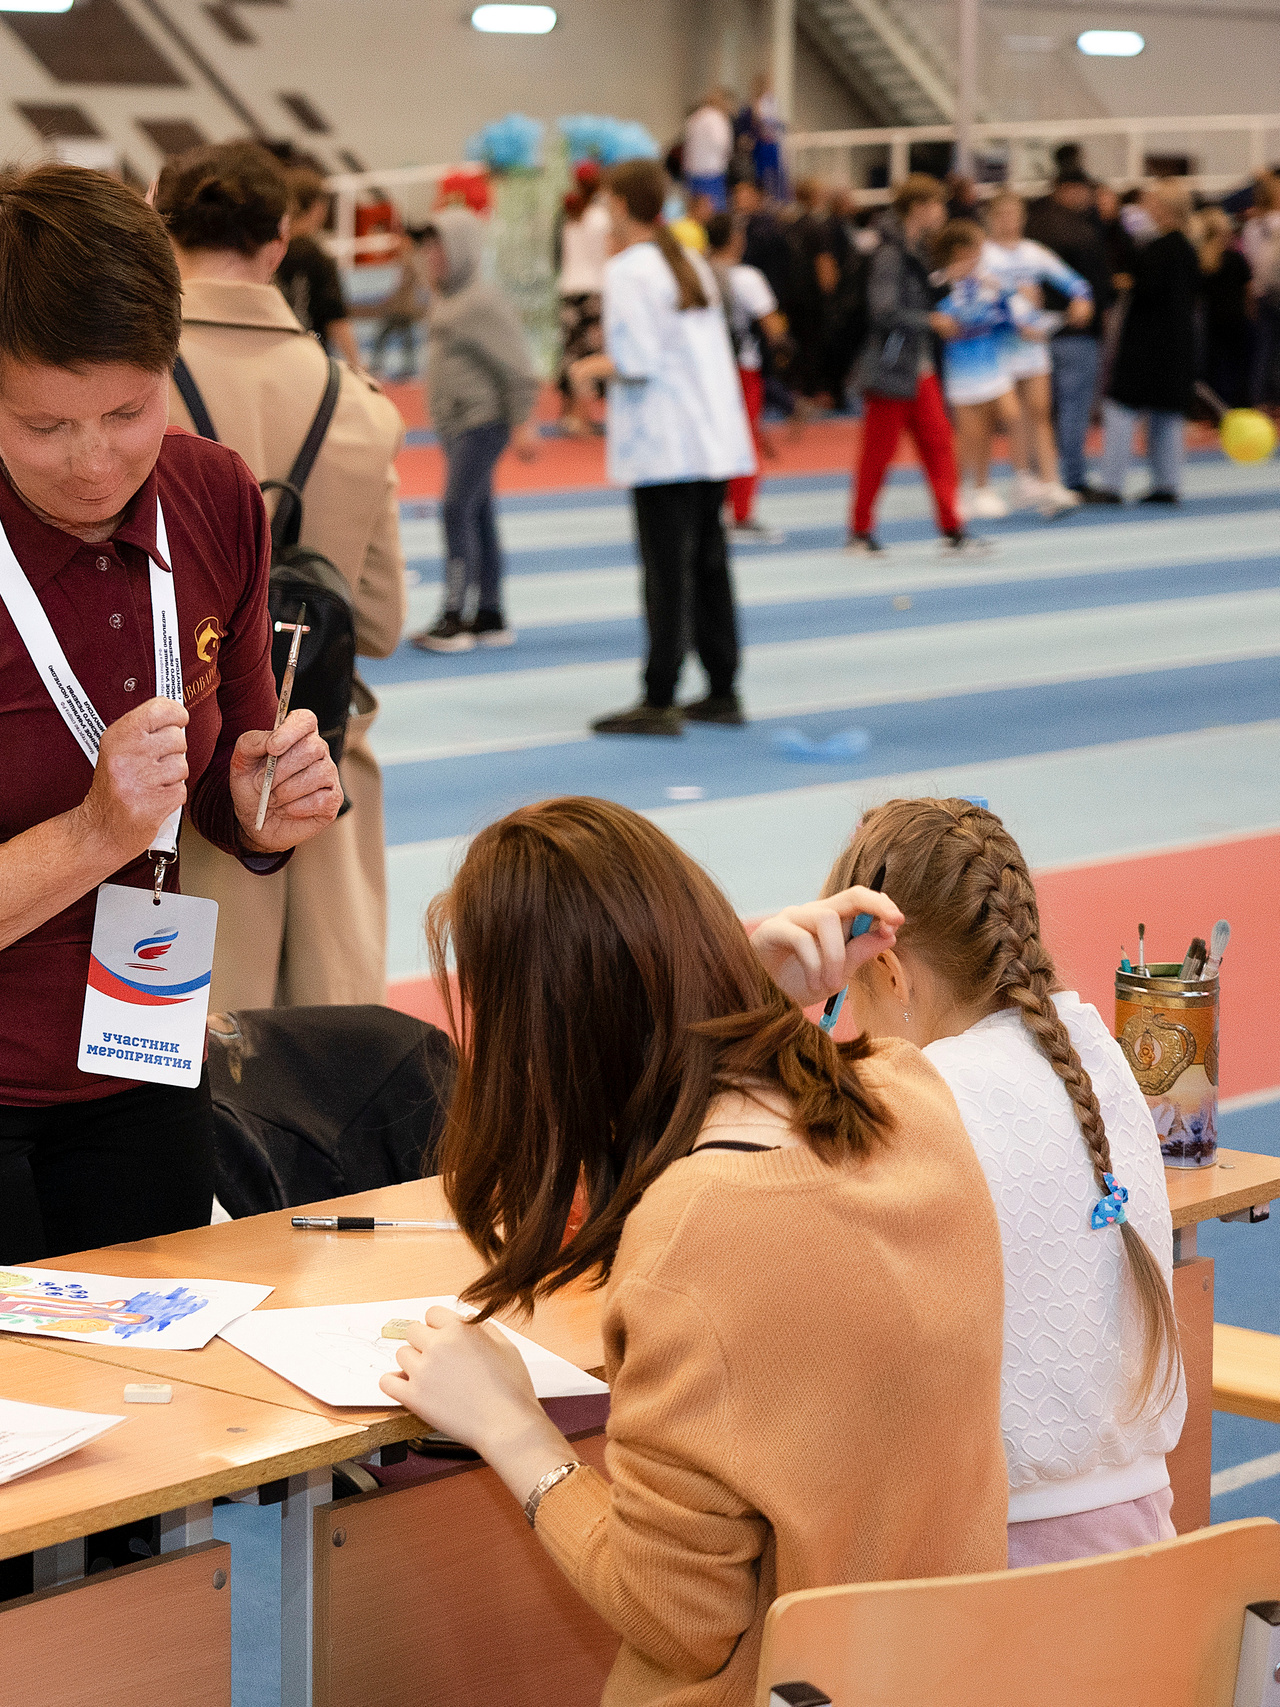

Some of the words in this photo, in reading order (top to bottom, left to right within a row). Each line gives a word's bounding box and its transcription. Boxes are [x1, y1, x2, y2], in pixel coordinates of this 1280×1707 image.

[60, 701, 67, 709] РФ
[66, 685, 85, 713] РЕЗЕРВА
[73, 723, 95, 755] Министерство
